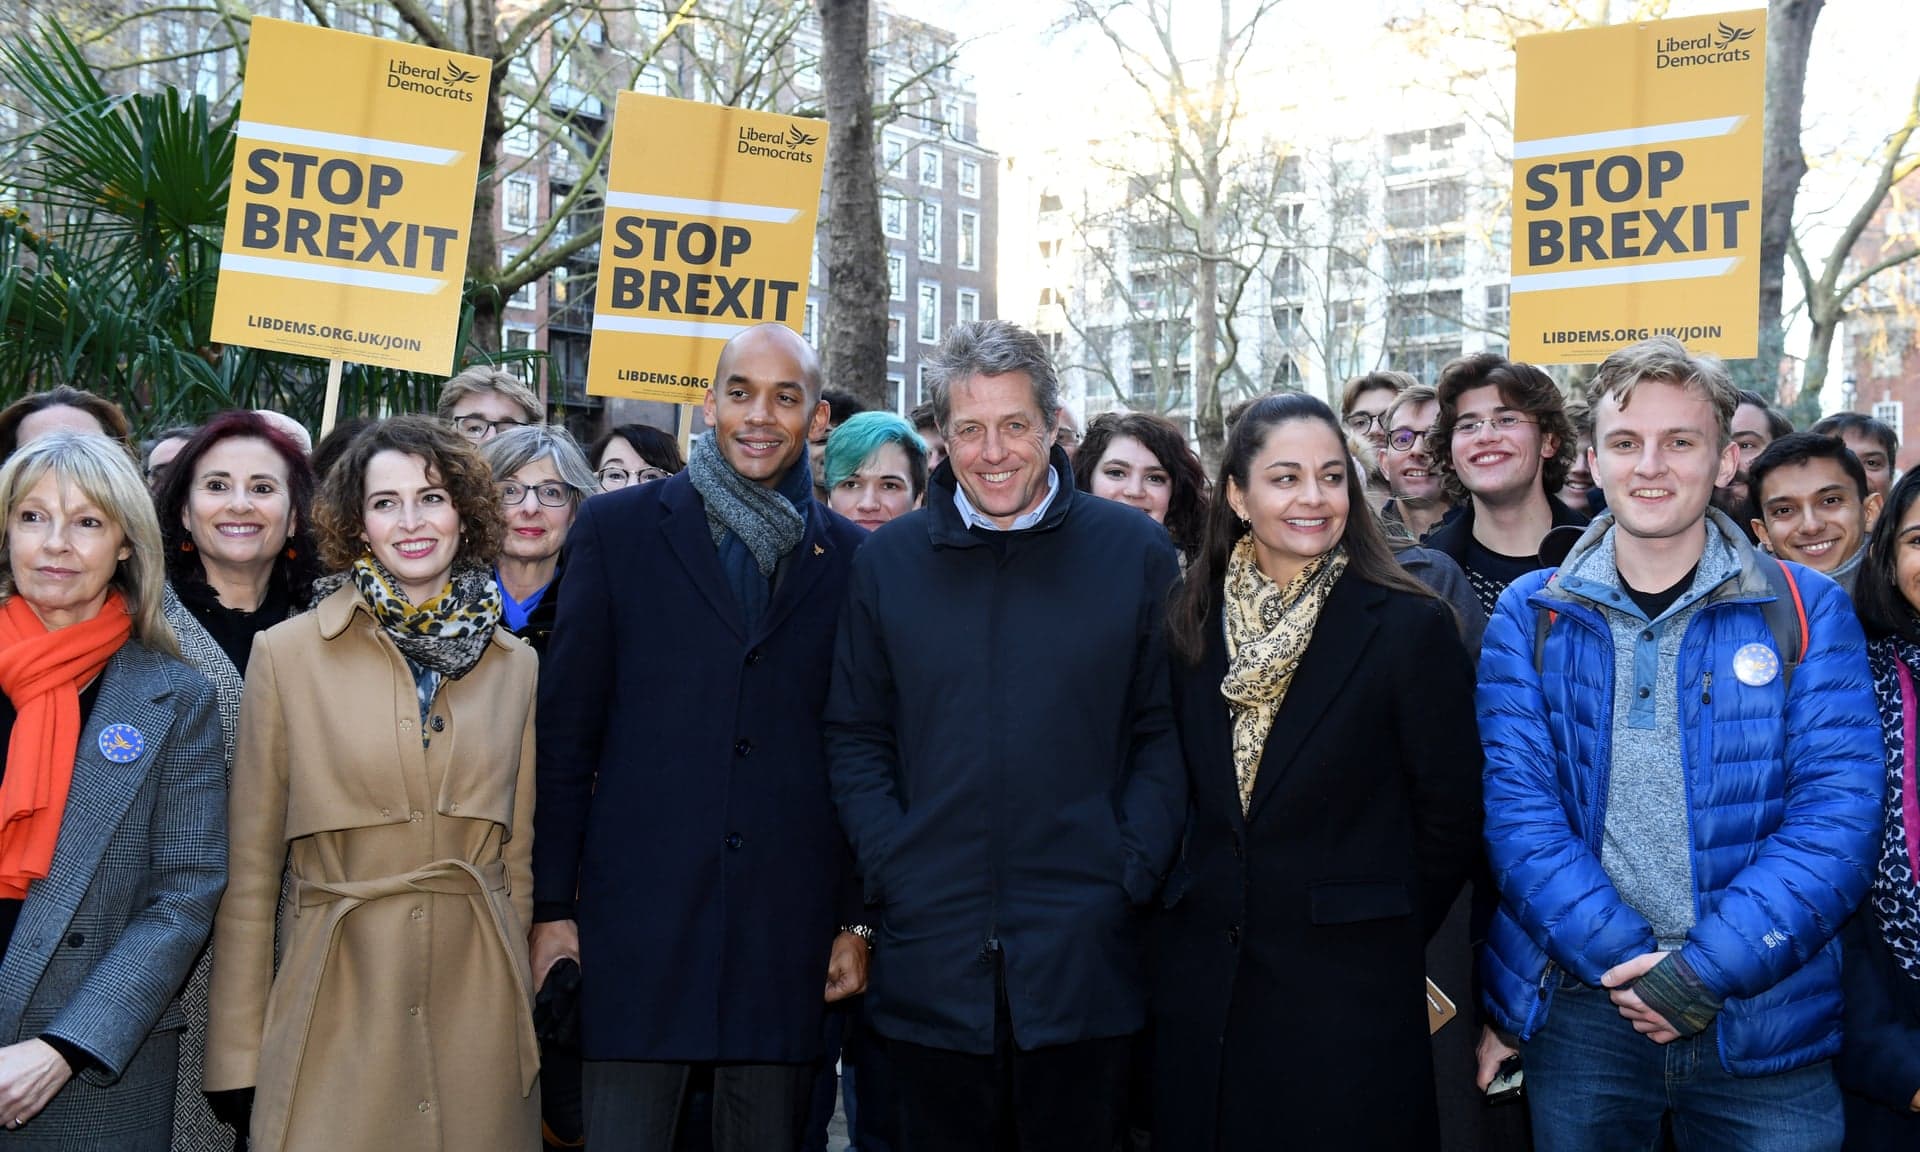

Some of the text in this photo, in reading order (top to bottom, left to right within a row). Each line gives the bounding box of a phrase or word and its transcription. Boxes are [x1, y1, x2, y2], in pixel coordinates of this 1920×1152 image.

[1656, 32, 1712, 54] Liberal
[389, 59, 440, 82] Liberal
[1656, 48, 1750, 70] Democrats
[387, 73, 473, 103] Democrats
[739, 126, 784, 145] Liberal
[737, 140, 813, 164] Democrats
[245, 148, 404, 210] STOP
[1525, 150, 1684, 212] STOP
[242, 202, 459, 273] BREXIT
[613, 215, 752, 268] STOP
[1527, 199, 1750, 267] BREXIT
[611, 266, 799, 322] BREXIT
[248, 314, 421, 352] LIBDEMS.ORG.UK/JOIN
[1543, 325, 1722, 345] LIBDEMS.ORGUK/JOIN
[617, 369, 710, 389] LIBDEMS.ORG
